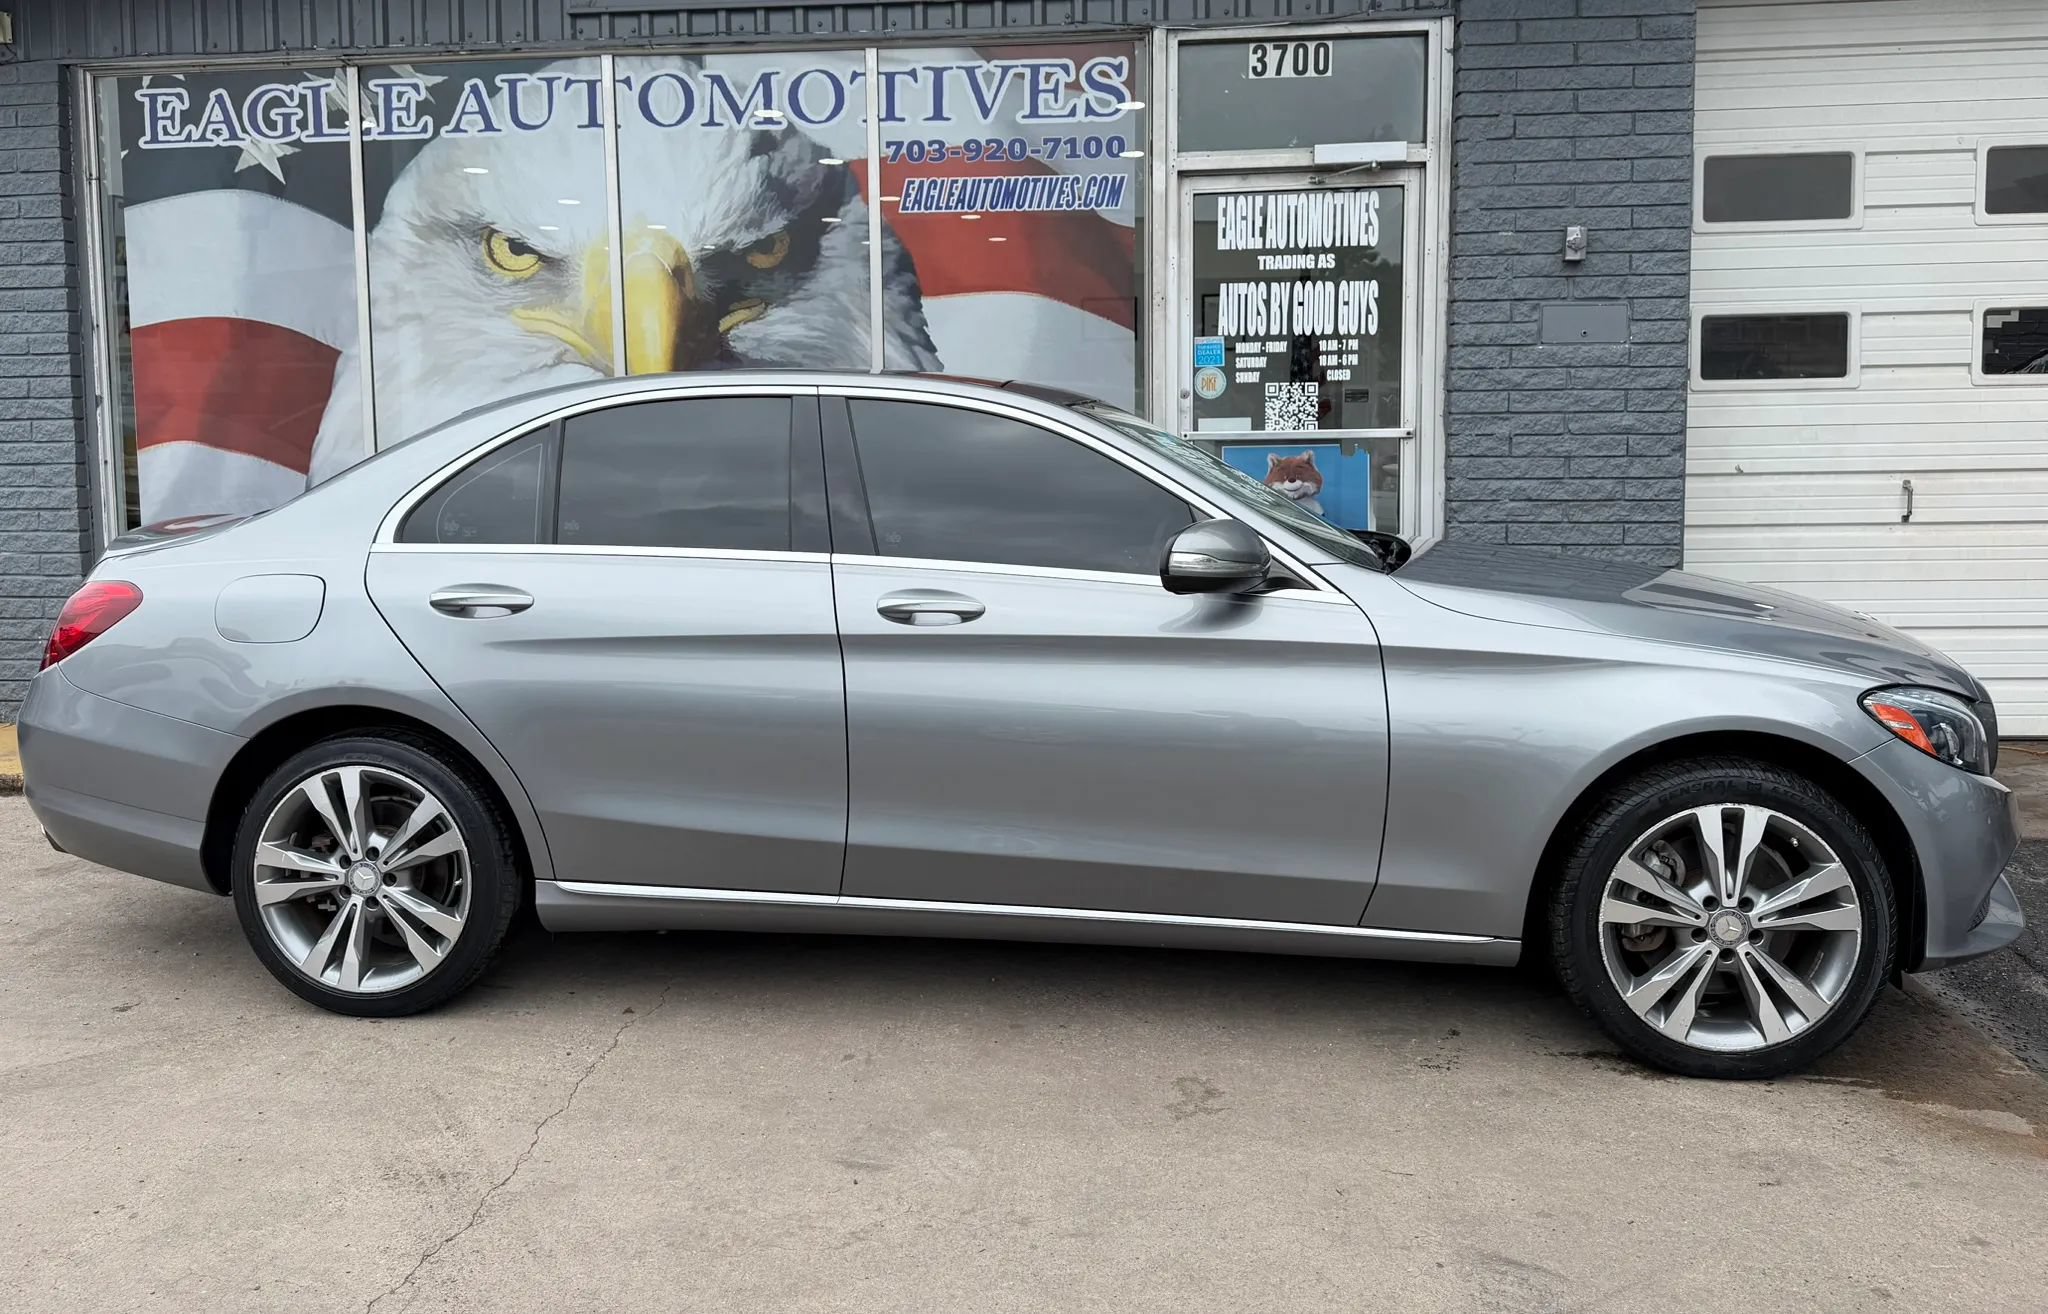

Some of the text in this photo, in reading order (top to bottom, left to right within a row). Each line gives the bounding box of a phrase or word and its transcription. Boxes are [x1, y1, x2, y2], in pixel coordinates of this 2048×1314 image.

[1251, 41, 1330, 77] 3700
[138, 59, 1131, 147] EAGLE AUTOMOTIVES
[884, 135, 1127, 164] 703-920-7100
[900, 174, 1127, 213] EAGLEAUTOMOTIVES.COM
[1217, 191, 1380, 250] EAGLE AUTOMOTIVES
[1257, 253, 1336, 270] TRADING AS
[1217, 280, 1379, 337] AUTOS BY GOOD GUYS
[1235, 341, 1262, 354] MONDAY
[1265, 340, 1288, 353] FRIDAY
[1319, 339, 1327, 352] 10
[1327, 339, 1338, 352] AM
[1347, 338, 1359, 351] PM
[1235, 356, 1268, 369] SATURDAY
[1327, 354, 1338, 366] AM
[1347, 353, 1359, 366] PM
[1235, 371, 1261, 384] SUNDAY
[1326, 369, 1351, 381] CLOSED
